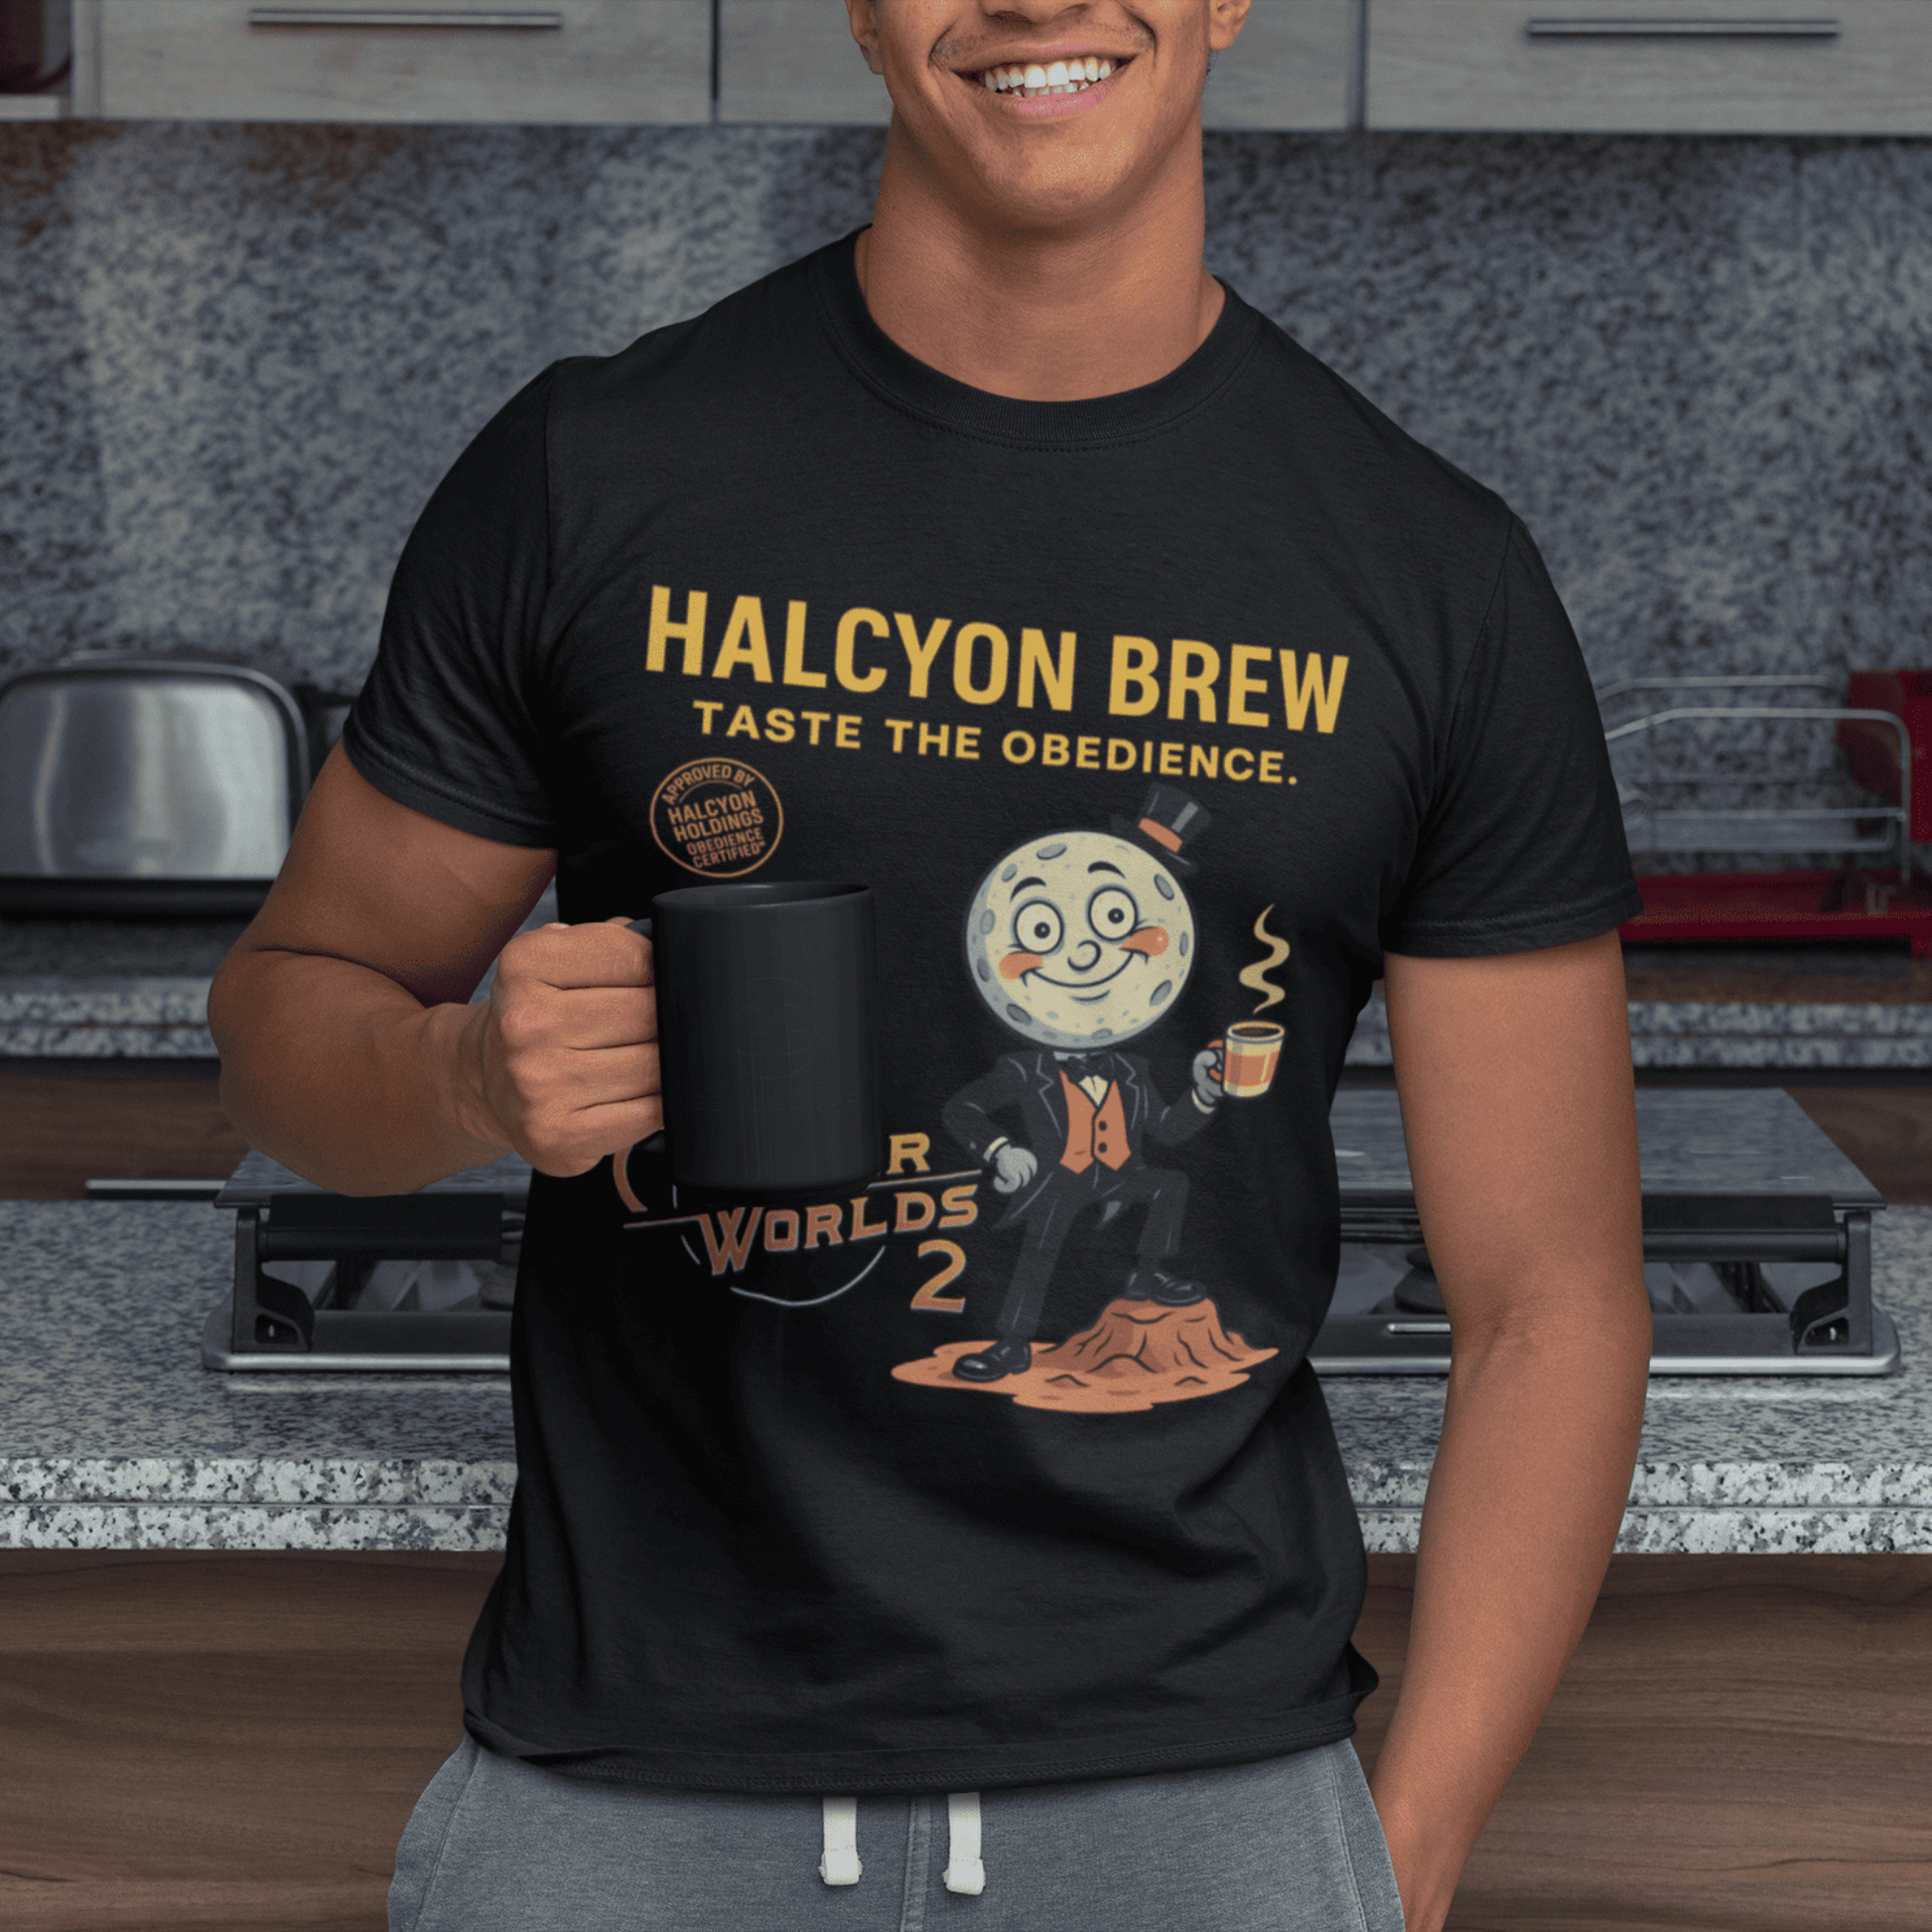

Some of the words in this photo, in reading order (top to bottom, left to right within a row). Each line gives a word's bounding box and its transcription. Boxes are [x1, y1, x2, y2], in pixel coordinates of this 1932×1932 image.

[645, 585, 1077, 712] HALCYON
[1108, 634, 1349, 735] BREW
[693, 700, 863, 750] TASTE
[885, 719, 982, 759] THE
[1002, 730, 1298, 785] OBEDIENCE.
[661, 763, 732, 805] APPROVED
[734, 769, 755, 786] BY
[667, 789, 757, 825] HALCYON
[673, 808, 763, 842] HOLDINGS
[686, 827, 763, 855] OBEDIENCE
[698, 1184, 979, 1276] WORLDS
[909, 1239, 967, 1313] 2
